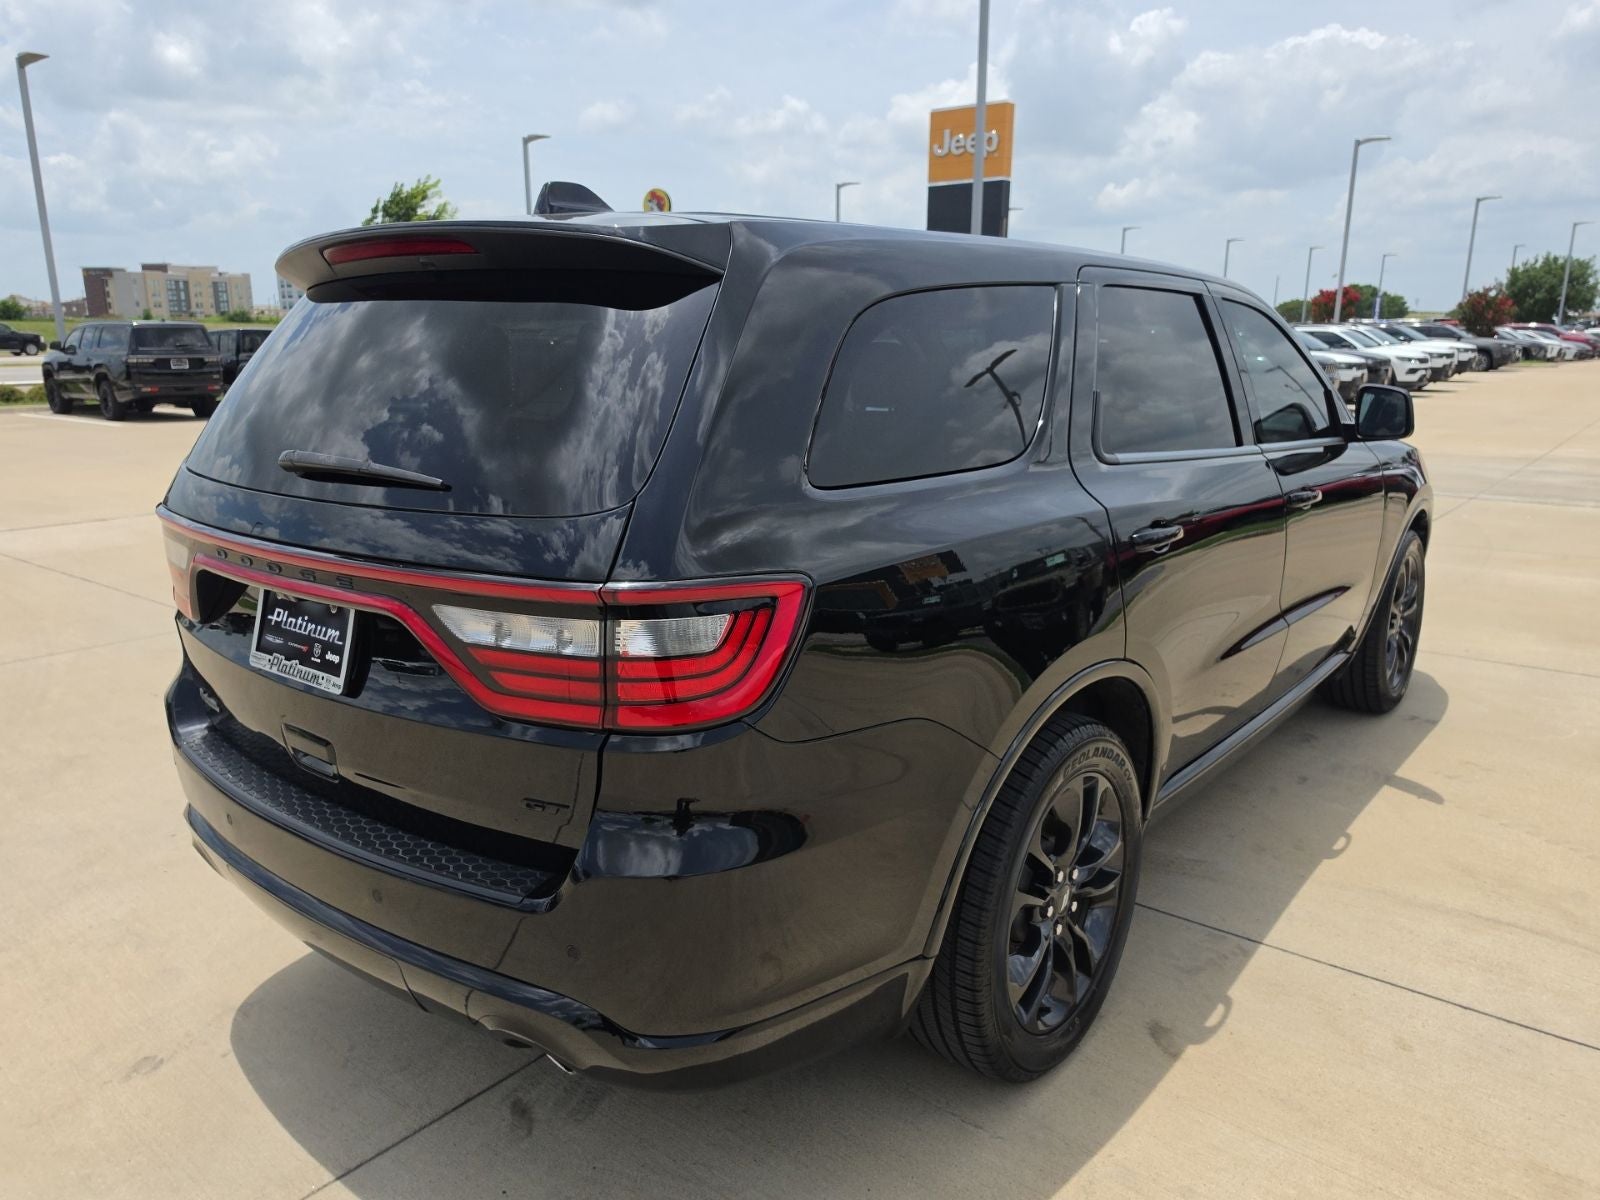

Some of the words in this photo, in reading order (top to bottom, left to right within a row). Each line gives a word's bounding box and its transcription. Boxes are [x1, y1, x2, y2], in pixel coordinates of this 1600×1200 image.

[933, 128, 999, 158] Jeep
[216, 549, 354, 589] DODGE
[267, 607, 343, 645] Platinum
[270, 654, 322, 686] Platinum
[1064, 746, 1126, 778] GEOLANDAR
